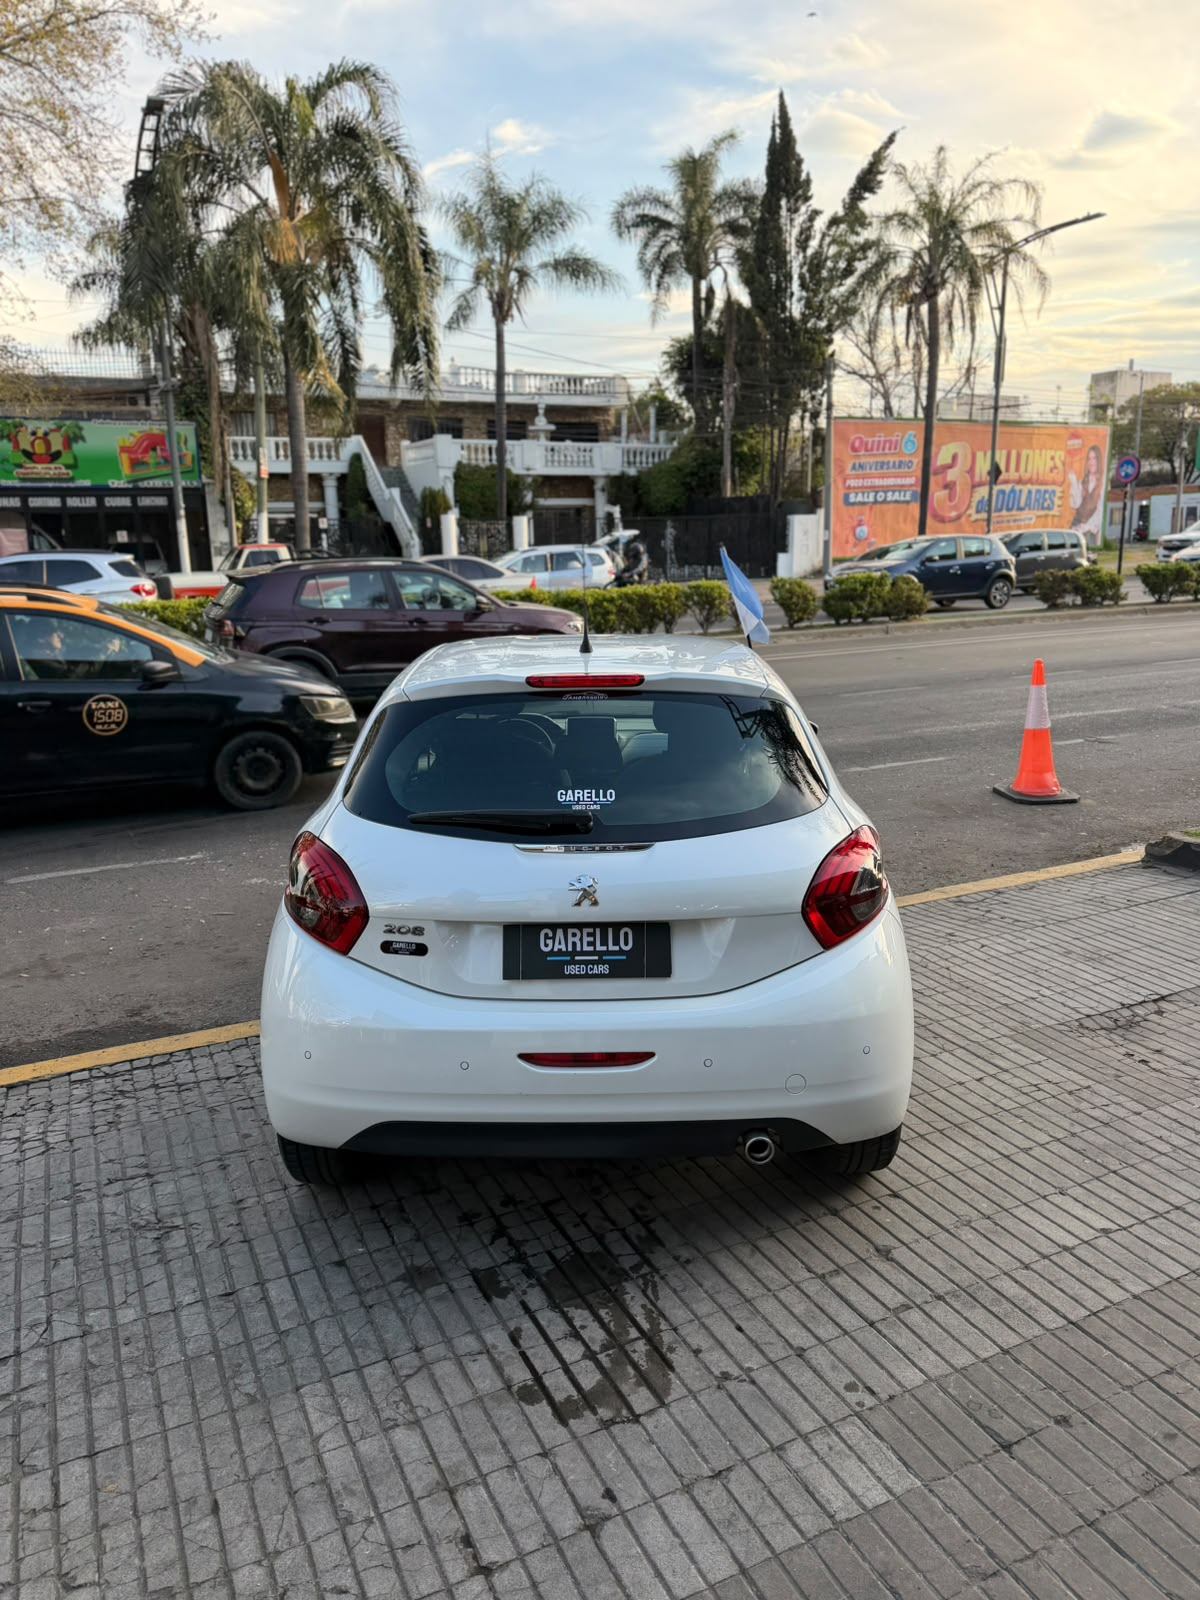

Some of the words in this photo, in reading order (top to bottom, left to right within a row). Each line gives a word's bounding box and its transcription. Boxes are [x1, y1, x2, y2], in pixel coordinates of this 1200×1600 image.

[849, 434, 900, 455] Quini
[849, 459, 915, 473] ANIVERSARIO
[931, 441, 973, 523] 3
[66, 496, 97, 508] ROLLER
[848, 491, 876, 503] SALE
[875, 491, 886, 502] O
[886, 490, 913, 502] SALE
[994, 486, 1056, 512] DÓLARES
[91, 701, 119, 709] TAXI
[94, 709, 123, 722] 1508
[557, 788, 616, 802] GARELLO
[383, 923, 425, 936] 208
[539, 927, 633, 952] GARELLO
[564, 964, 586, 975] USED
[587, 964, 610, 975] CARS
